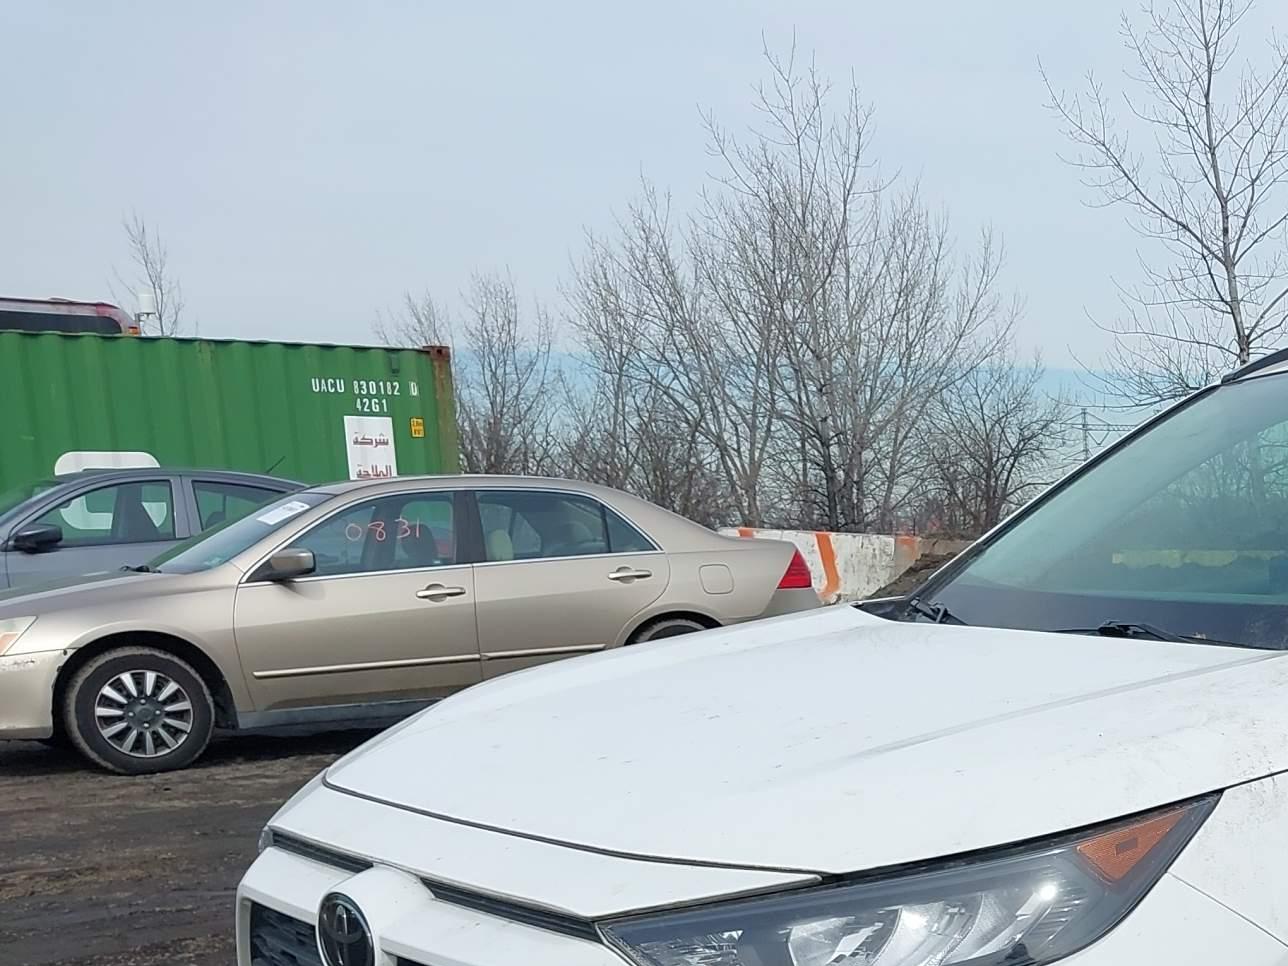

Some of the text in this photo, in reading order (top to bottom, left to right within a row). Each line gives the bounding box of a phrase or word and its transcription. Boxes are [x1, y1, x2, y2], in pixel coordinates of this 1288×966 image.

[311, 378, 345, 393] UACU
[353, 380, 400, 396] 830182
[356, 398, 388, 412] 42G1
[352, 432, 389, 448] شركة
[345, 517, 420, 541] 0831
